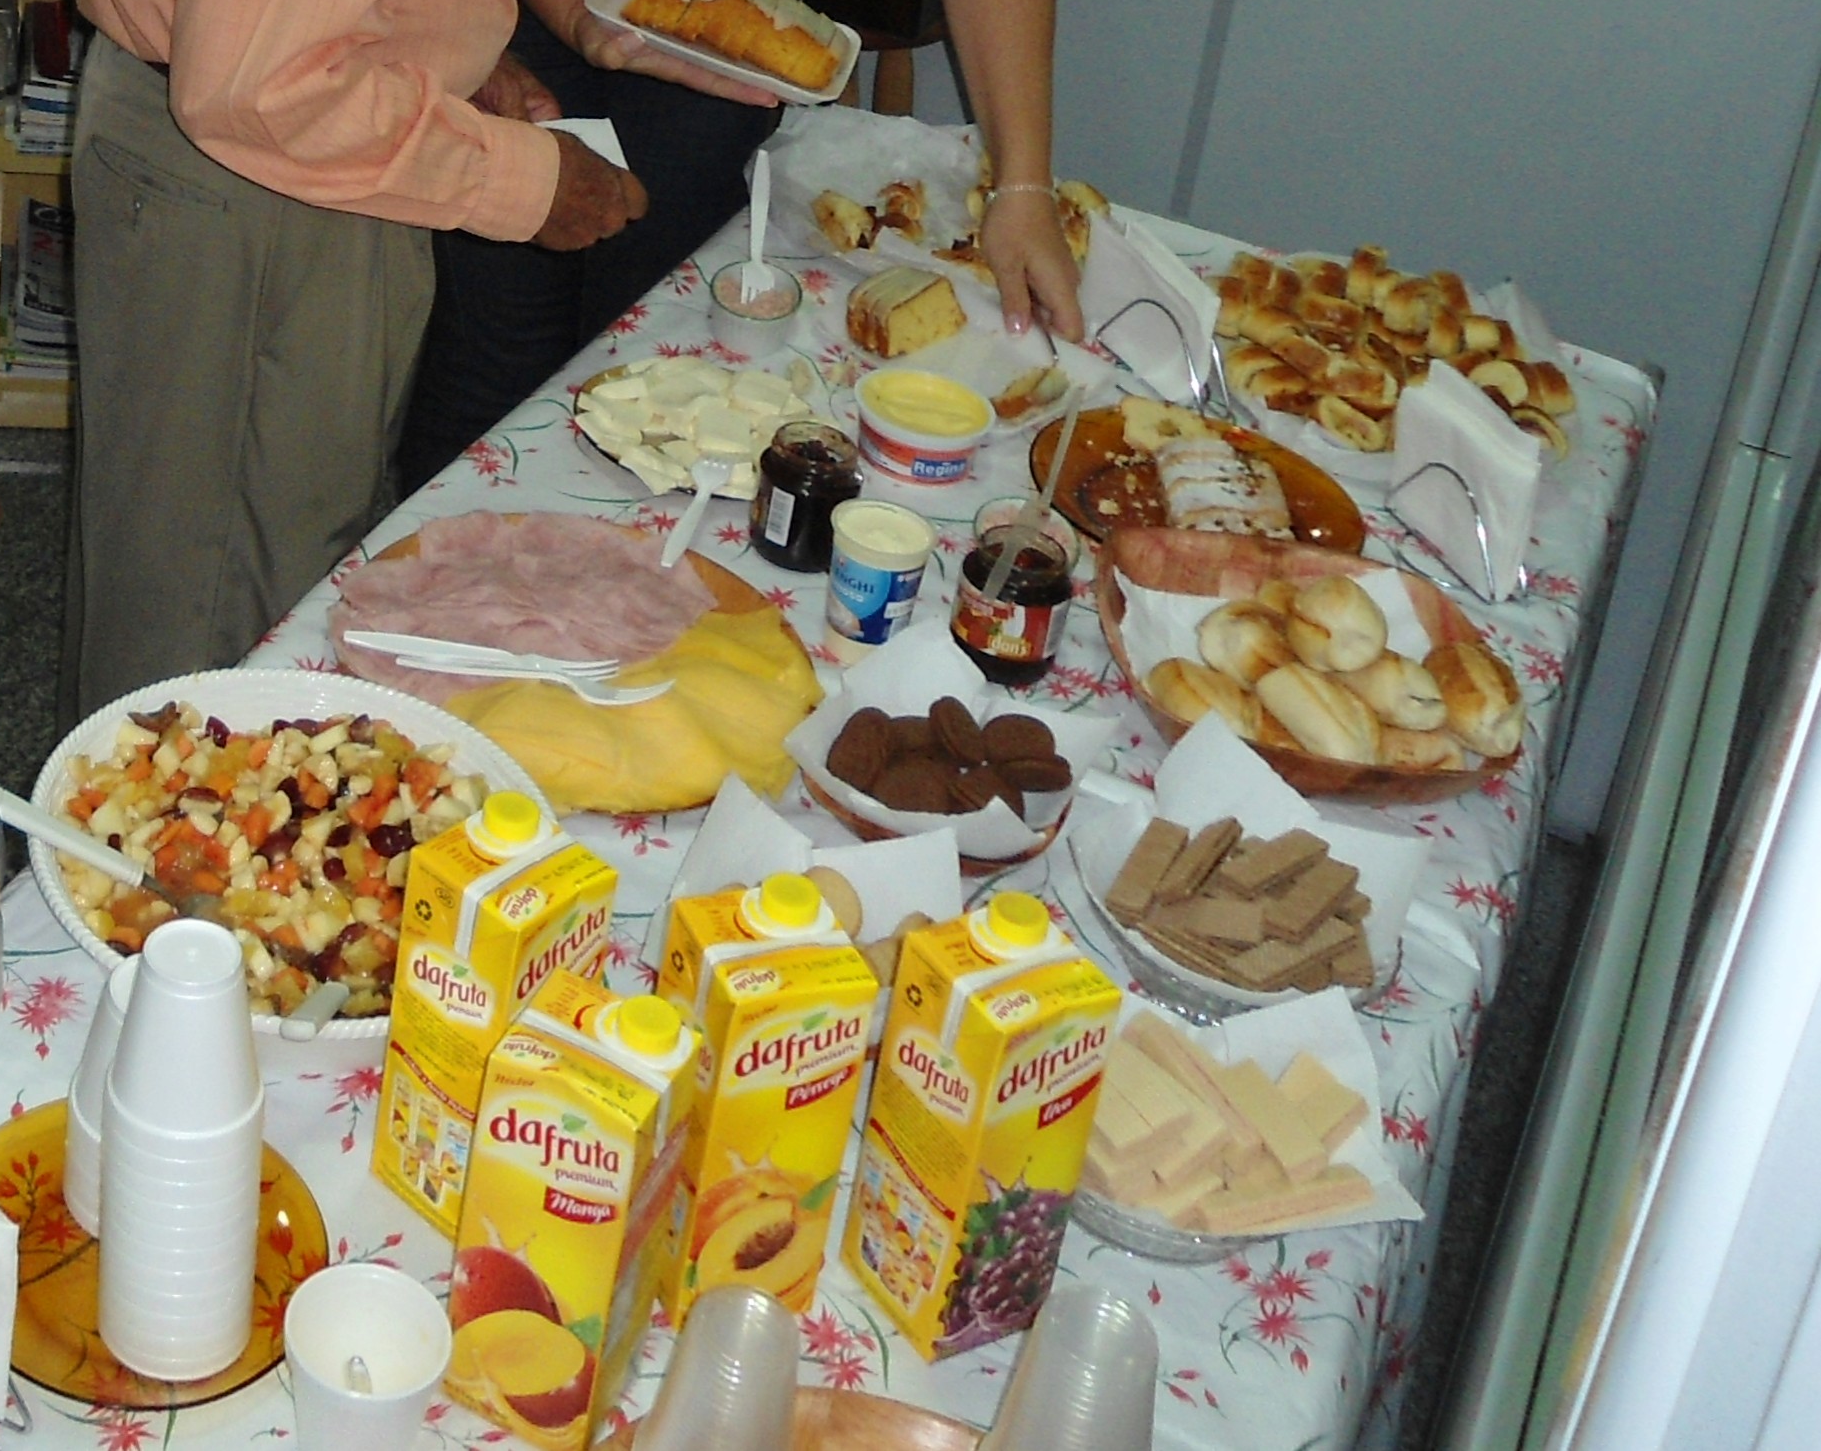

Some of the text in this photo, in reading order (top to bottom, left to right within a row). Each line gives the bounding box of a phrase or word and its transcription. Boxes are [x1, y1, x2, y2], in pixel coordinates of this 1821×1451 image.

[413, 953, 488, 1008] dafruta
[516, 906, 607, 1000] dafruta
[734, 1017, 861, 1078] dafruta
[898, 1039, 970, 1104] dafruta
[997, 1025, 1107, 1104] dafruta
[489, 1107, 620, 1174] dafruta
[550, 1190, 611, 1224] Manga
[554, 1167, 619, 1193] premium
